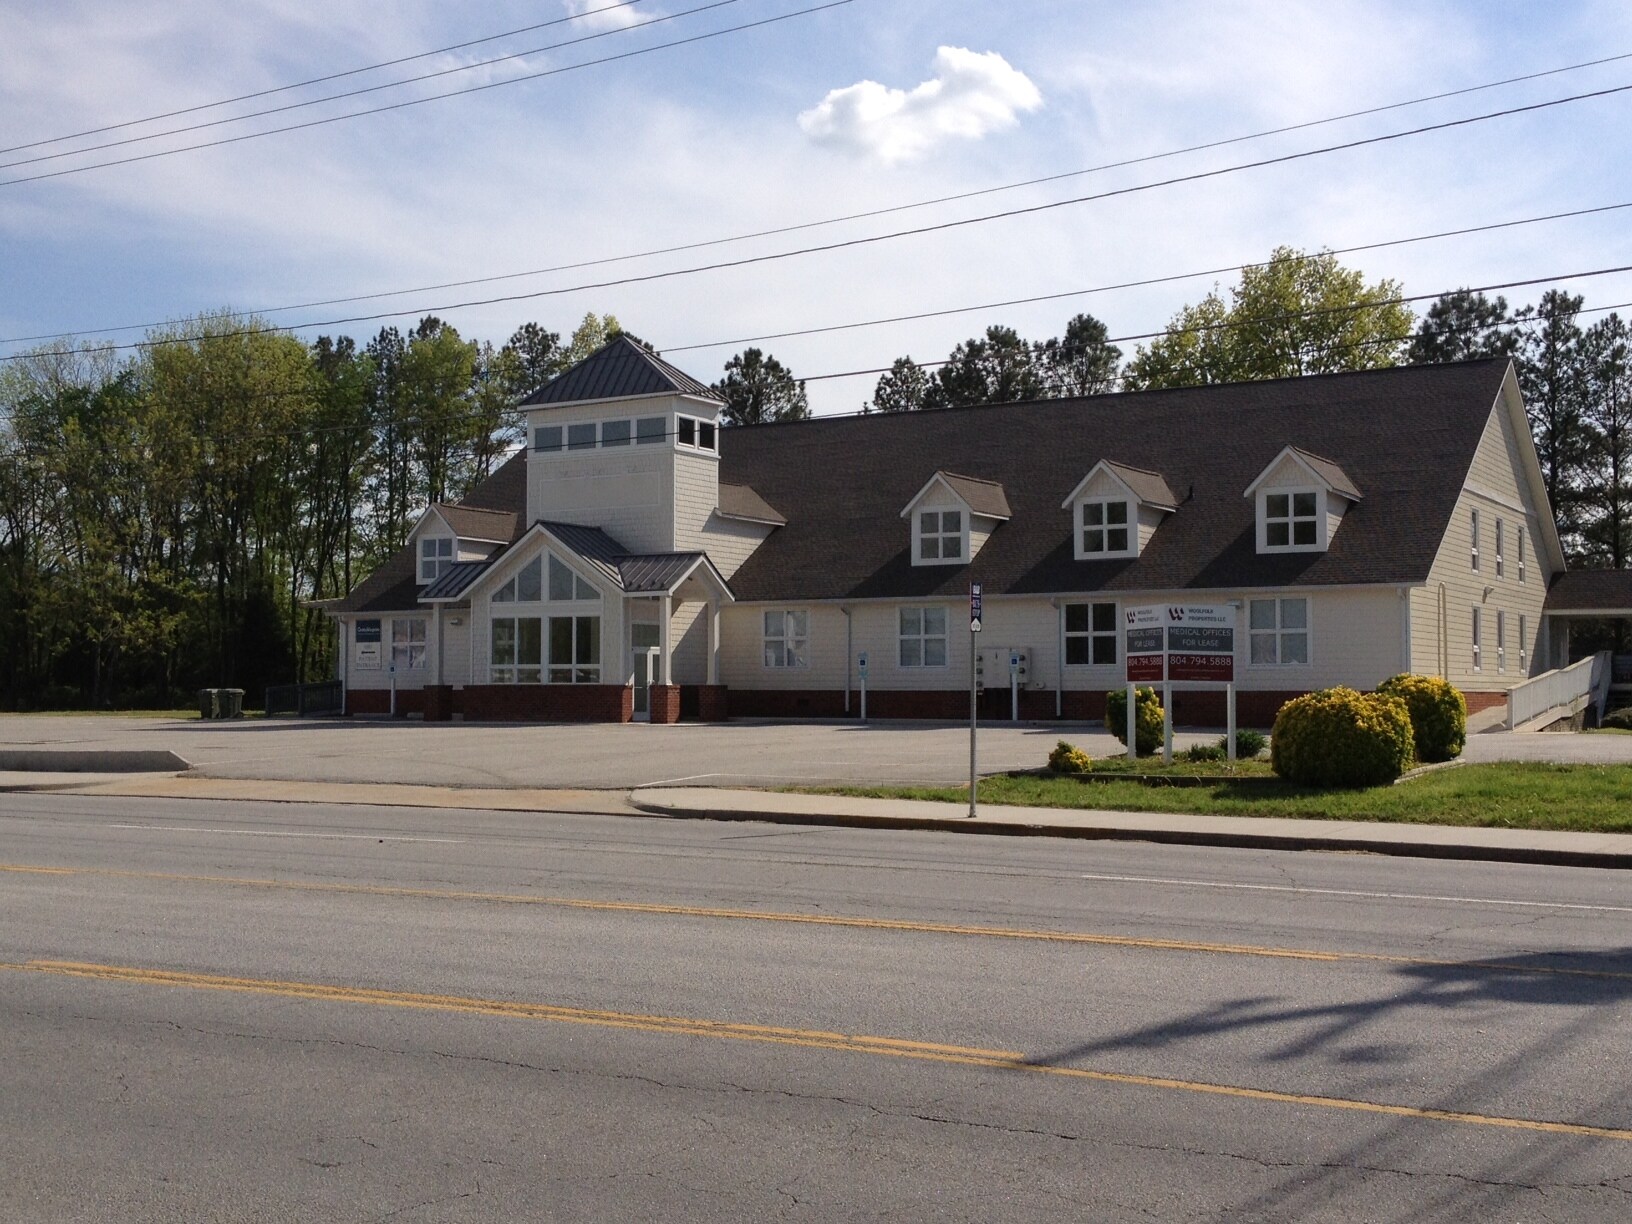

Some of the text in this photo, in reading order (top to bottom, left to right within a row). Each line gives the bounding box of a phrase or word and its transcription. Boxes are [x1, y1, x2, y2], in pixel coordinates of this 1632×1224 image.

[1169, 628, 1200, 636] MEDICAL
[1198, 639, 1219, 647] LEASE
[1169, 656, 1232, 666] 804.794.5888
